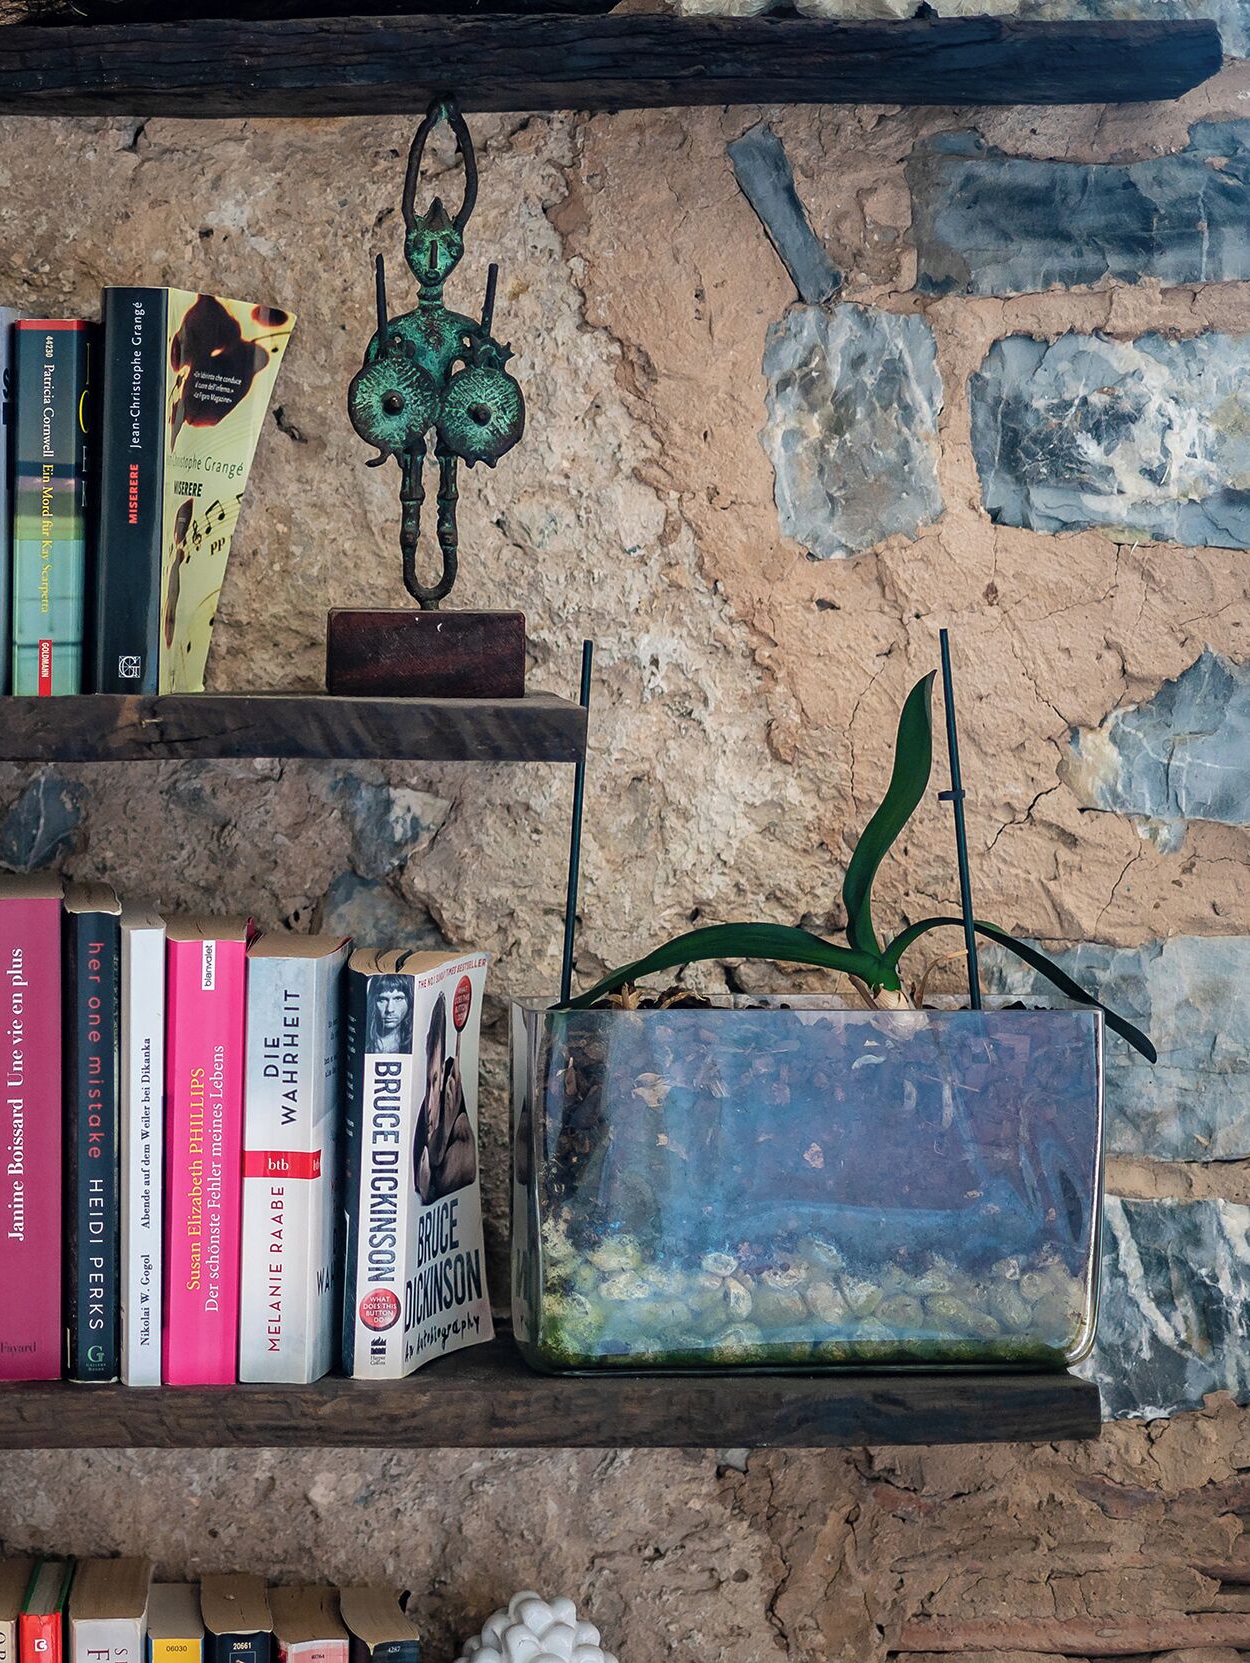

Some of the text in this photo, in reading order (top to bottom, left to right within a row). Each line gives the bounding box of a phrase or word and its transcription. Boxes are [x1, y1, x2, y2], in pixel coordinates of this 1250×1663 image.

[43, 364, 55, 404] Patricia
[129, 301, 146, 449] Jean-Christophe Grangé
[42, 407, 55, 457] Cornwell
[204, 456, 244, 479] Grangé
[42, 464, 54, 483] Ein
[42, 486, 54, 517] Mord
[128, 463, 140, 524] MISERERE
[39, 541, 53, 561] Kay
[41, 642, 50, 678] GOLDMANN
[204, 944, 213, 987] blanvalet
[88, 942, 105, 1159] her one mistake
[263, 1036, 280, 1078] DIE
[281, 989, 301, 1125] WAHRHEIT
[6, 948, 29, 1242] Janine Boissard Une vie en plus
[140, 1038, 153, 1347] Nikolai W. Gogol Abende auf dem Weiler bei Dikanka
[187, 1068, 205, 1291] Susan Elizabeth PHILLIPS
[205, 1045, 225, 1312] Der schönste Fehler meines Lebens
[268, 1158, 289, 1171] btb
[367, 1061, 402, 1282] BRUCE DICKINSON
[89, 1179, 104, 1330] HEIDI PERKS
[267, 1185, 285, 1353] MELANIE RAABE
[417, 1198, 459, 1269] BRUCE
[404, 1248, 483, 1333] DICKINSON
